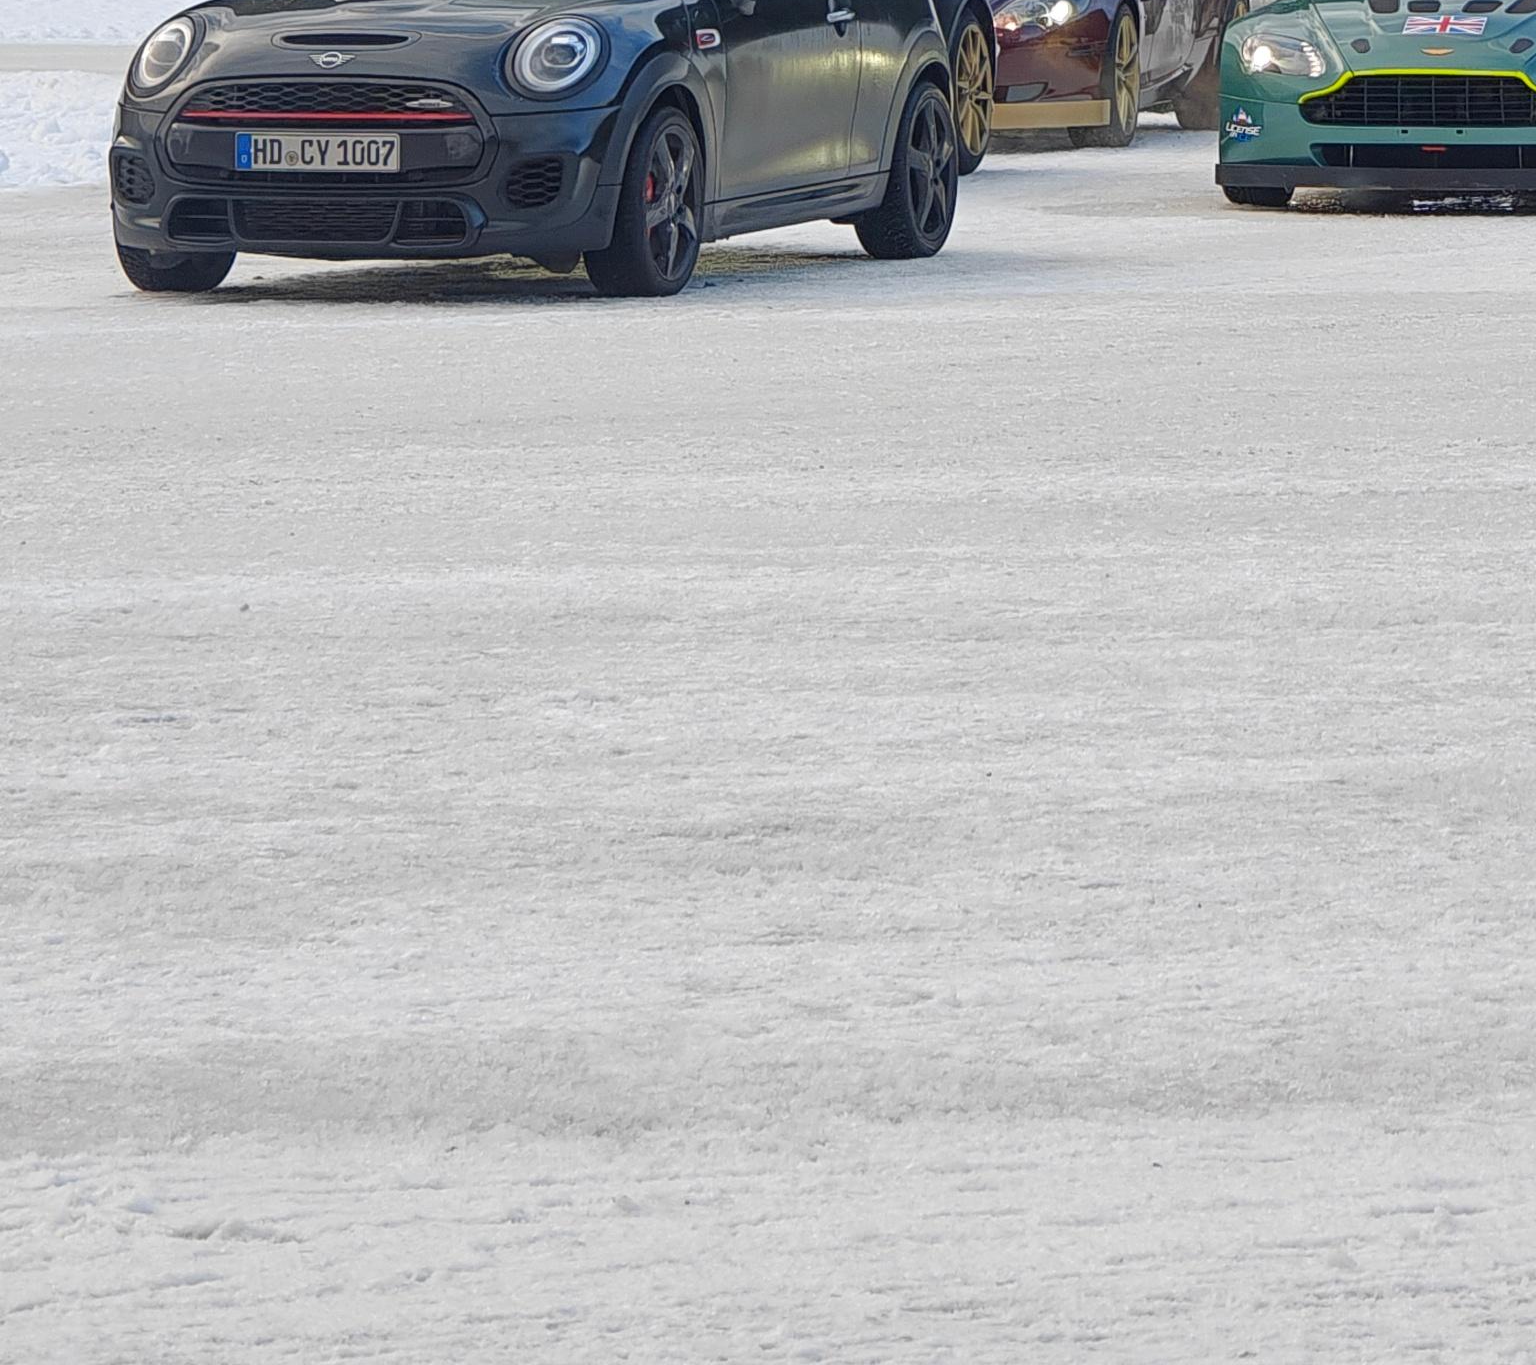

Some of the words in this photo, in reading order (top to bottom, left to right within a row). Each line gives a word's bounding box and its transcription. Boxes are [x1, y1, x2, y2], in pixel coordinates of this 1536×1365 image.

[253, 138, 283, 165] HD
[300, 139, 330, 166] CY
[336, 139, 395, 167] 1007
